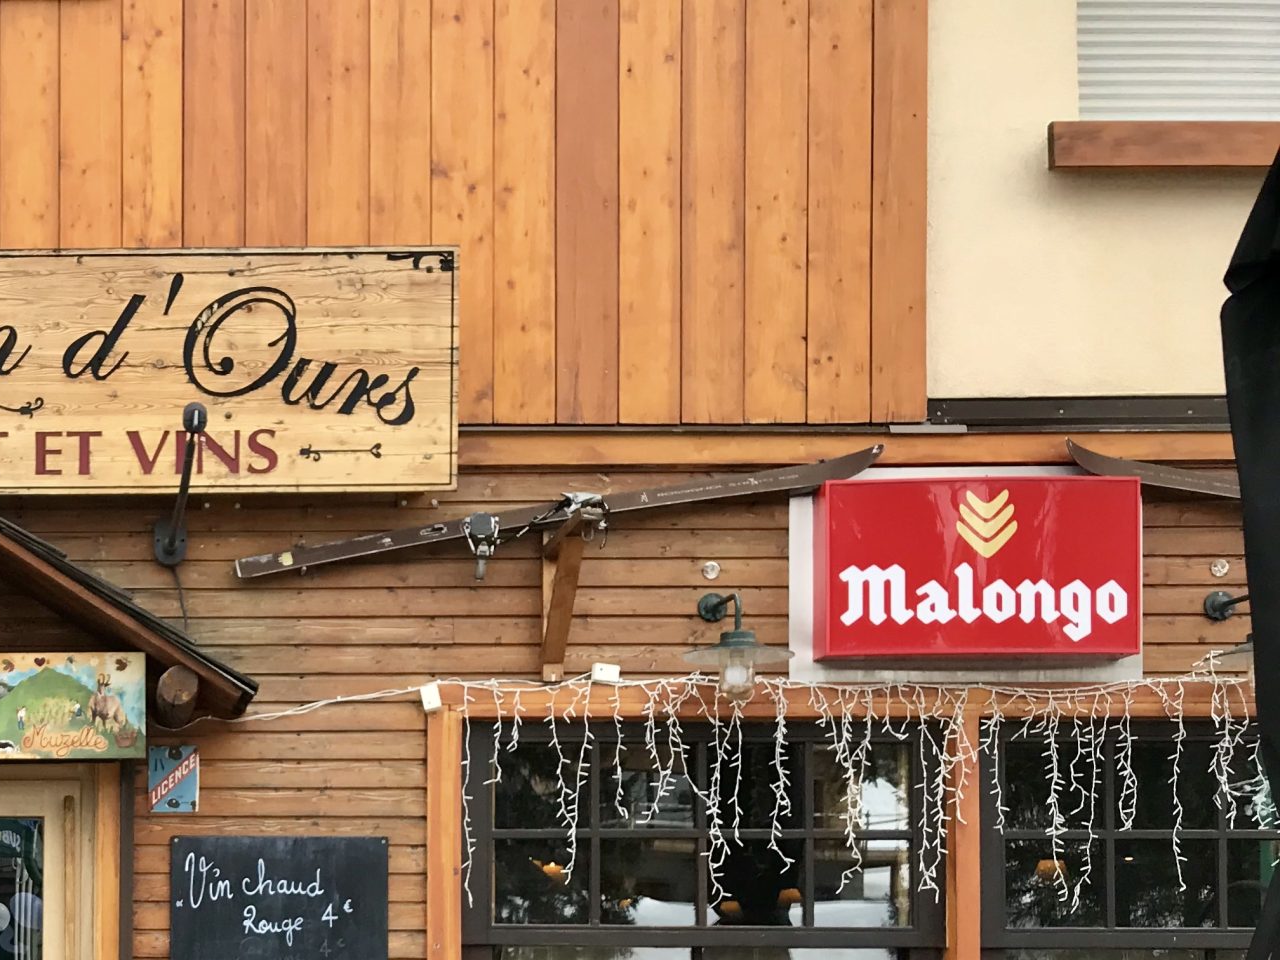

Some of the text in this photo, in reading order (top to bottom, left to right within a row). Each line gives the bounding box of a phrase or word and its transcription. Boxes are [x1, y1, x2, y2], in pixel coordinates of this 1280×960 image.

[35, 431, 102, 475] ET
[126, 429, 278, 475] VINS
[838, 562, 1128, 642] Malongo
[23, 723, 108, 757] Muzelle
[151, 753, 196, 806] LICENCE
[185, 852, 325, 909] Vin chaud
[243, 904, 304, 947] Rouge
